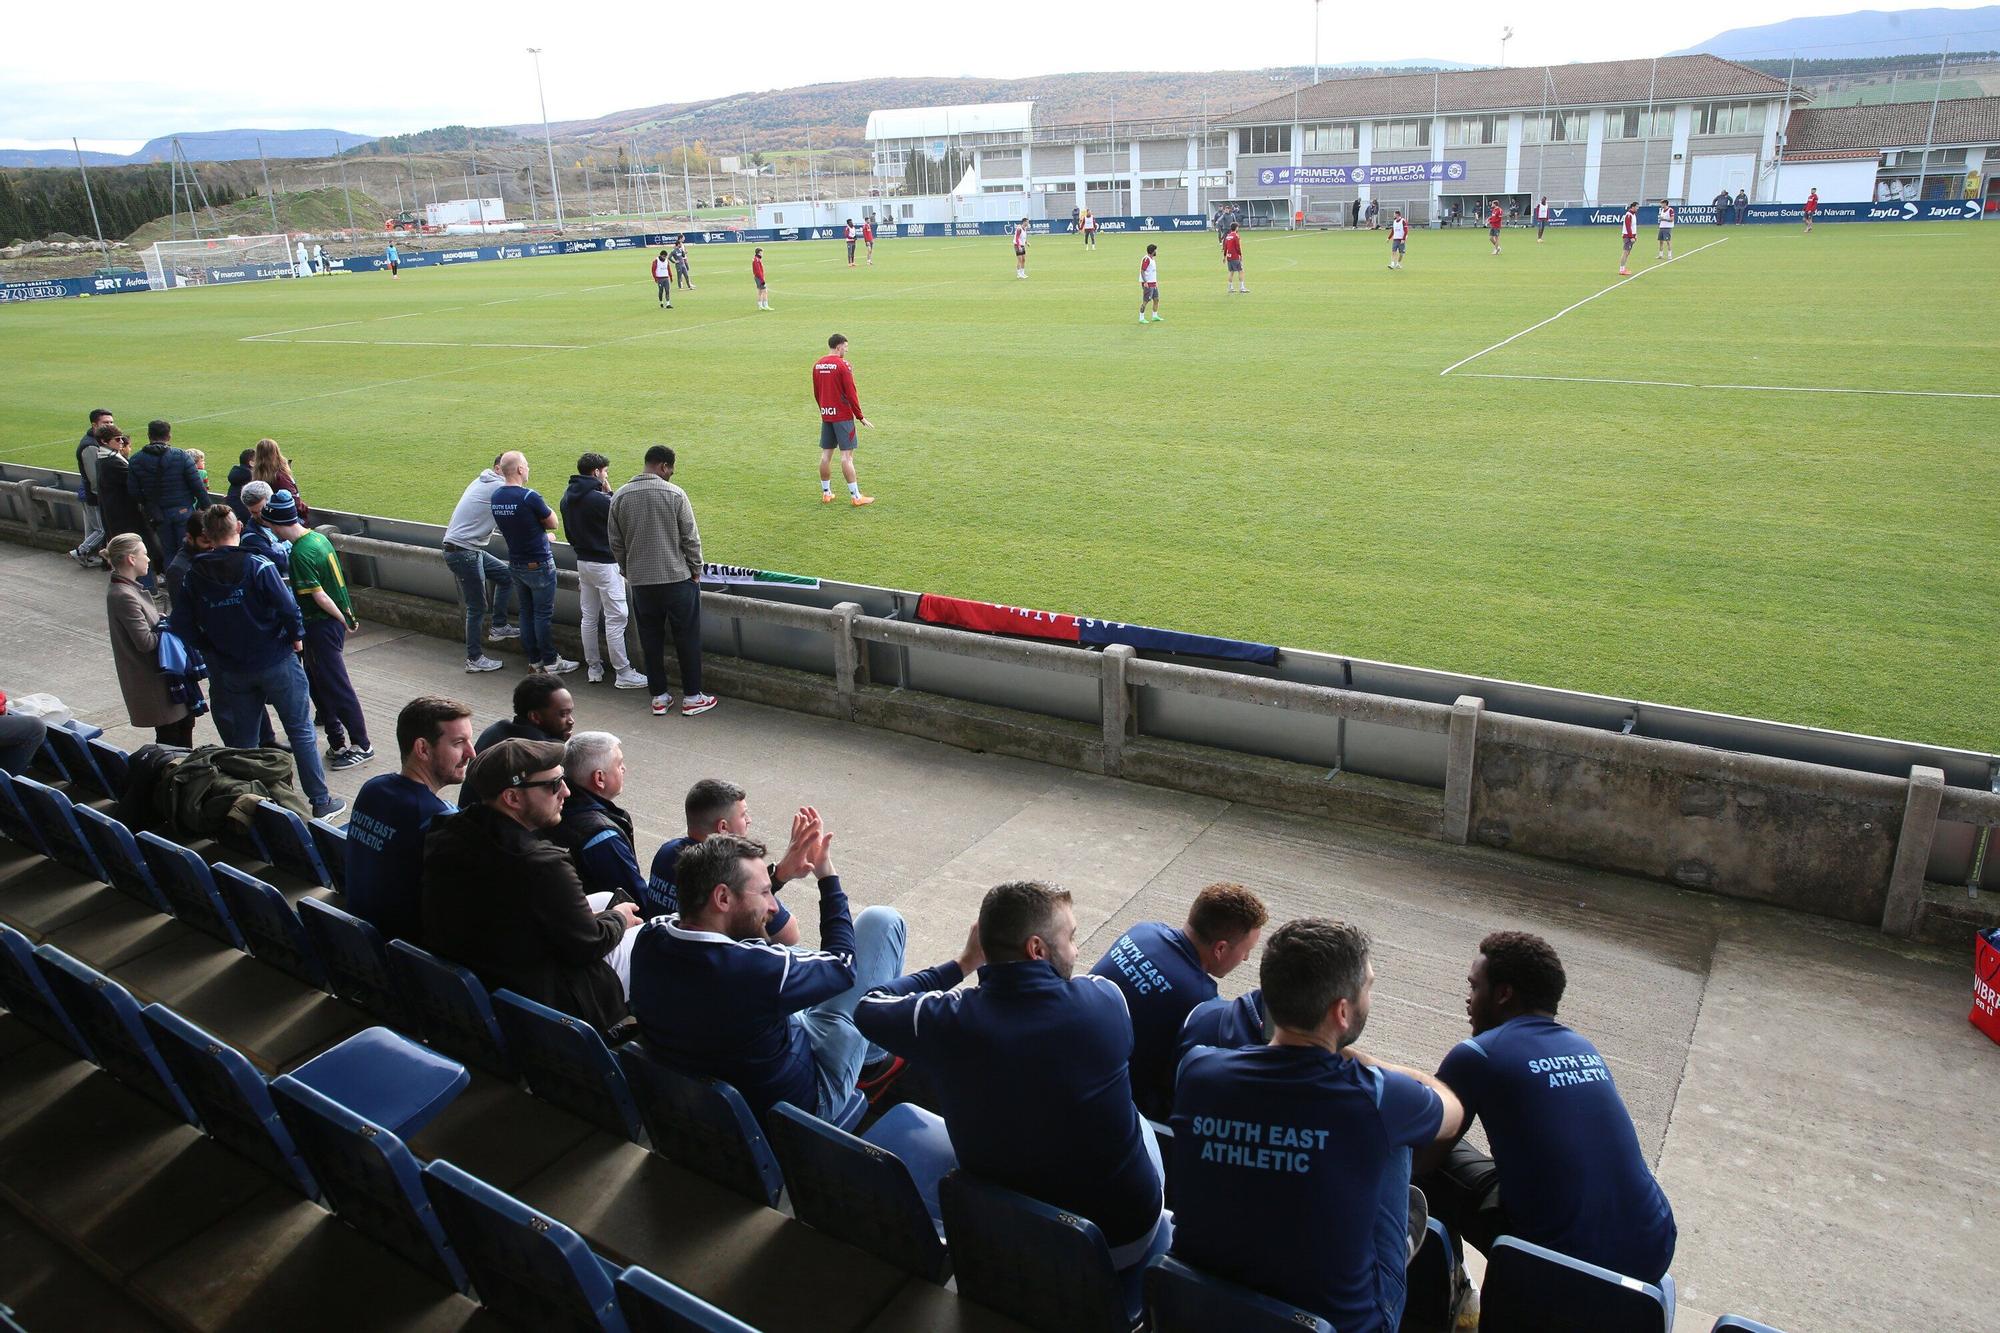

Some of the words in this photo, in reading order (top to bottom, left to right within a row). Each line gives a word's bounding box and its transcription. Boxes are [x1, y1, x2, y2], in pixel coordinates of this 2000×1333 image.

[1294, 169, 1345, 177] PRIMERA
[1370, 166, 1424, 175] PRIMERA
[1370, 174, 1425, 182] FEDERACIÓN
[1678, 206, 1705, 214] DIARIO
[1748, 209, 1778, 218] Parques
[1781, 208, 1808, 217] Solare
[1824, 208, 1856, 216] Navarra
[1868, 208, 1899, 218] Jaylo
[1928, 206, 1961, 216] Jaylo
[1677, 215, 1717, 223] NAVARRA
[221, 270, 245, 278] macron
[95, 278, 122, 290] SRT
[821, 407, 836, 415] DIGI
[1140, 959, 1174, 994] EAST
[1976, 998, 1984, 1009] en
[1528, 1055, 1579, 1075] SOUTH
[1579, 1053, 1606, 1068] EAS
[1192, 1115, 1261, 1143] SOUTH
[1269, 1125, 1330, 1150] EAST
[1200, 1141, 1311, 1174] ATHLETIC
